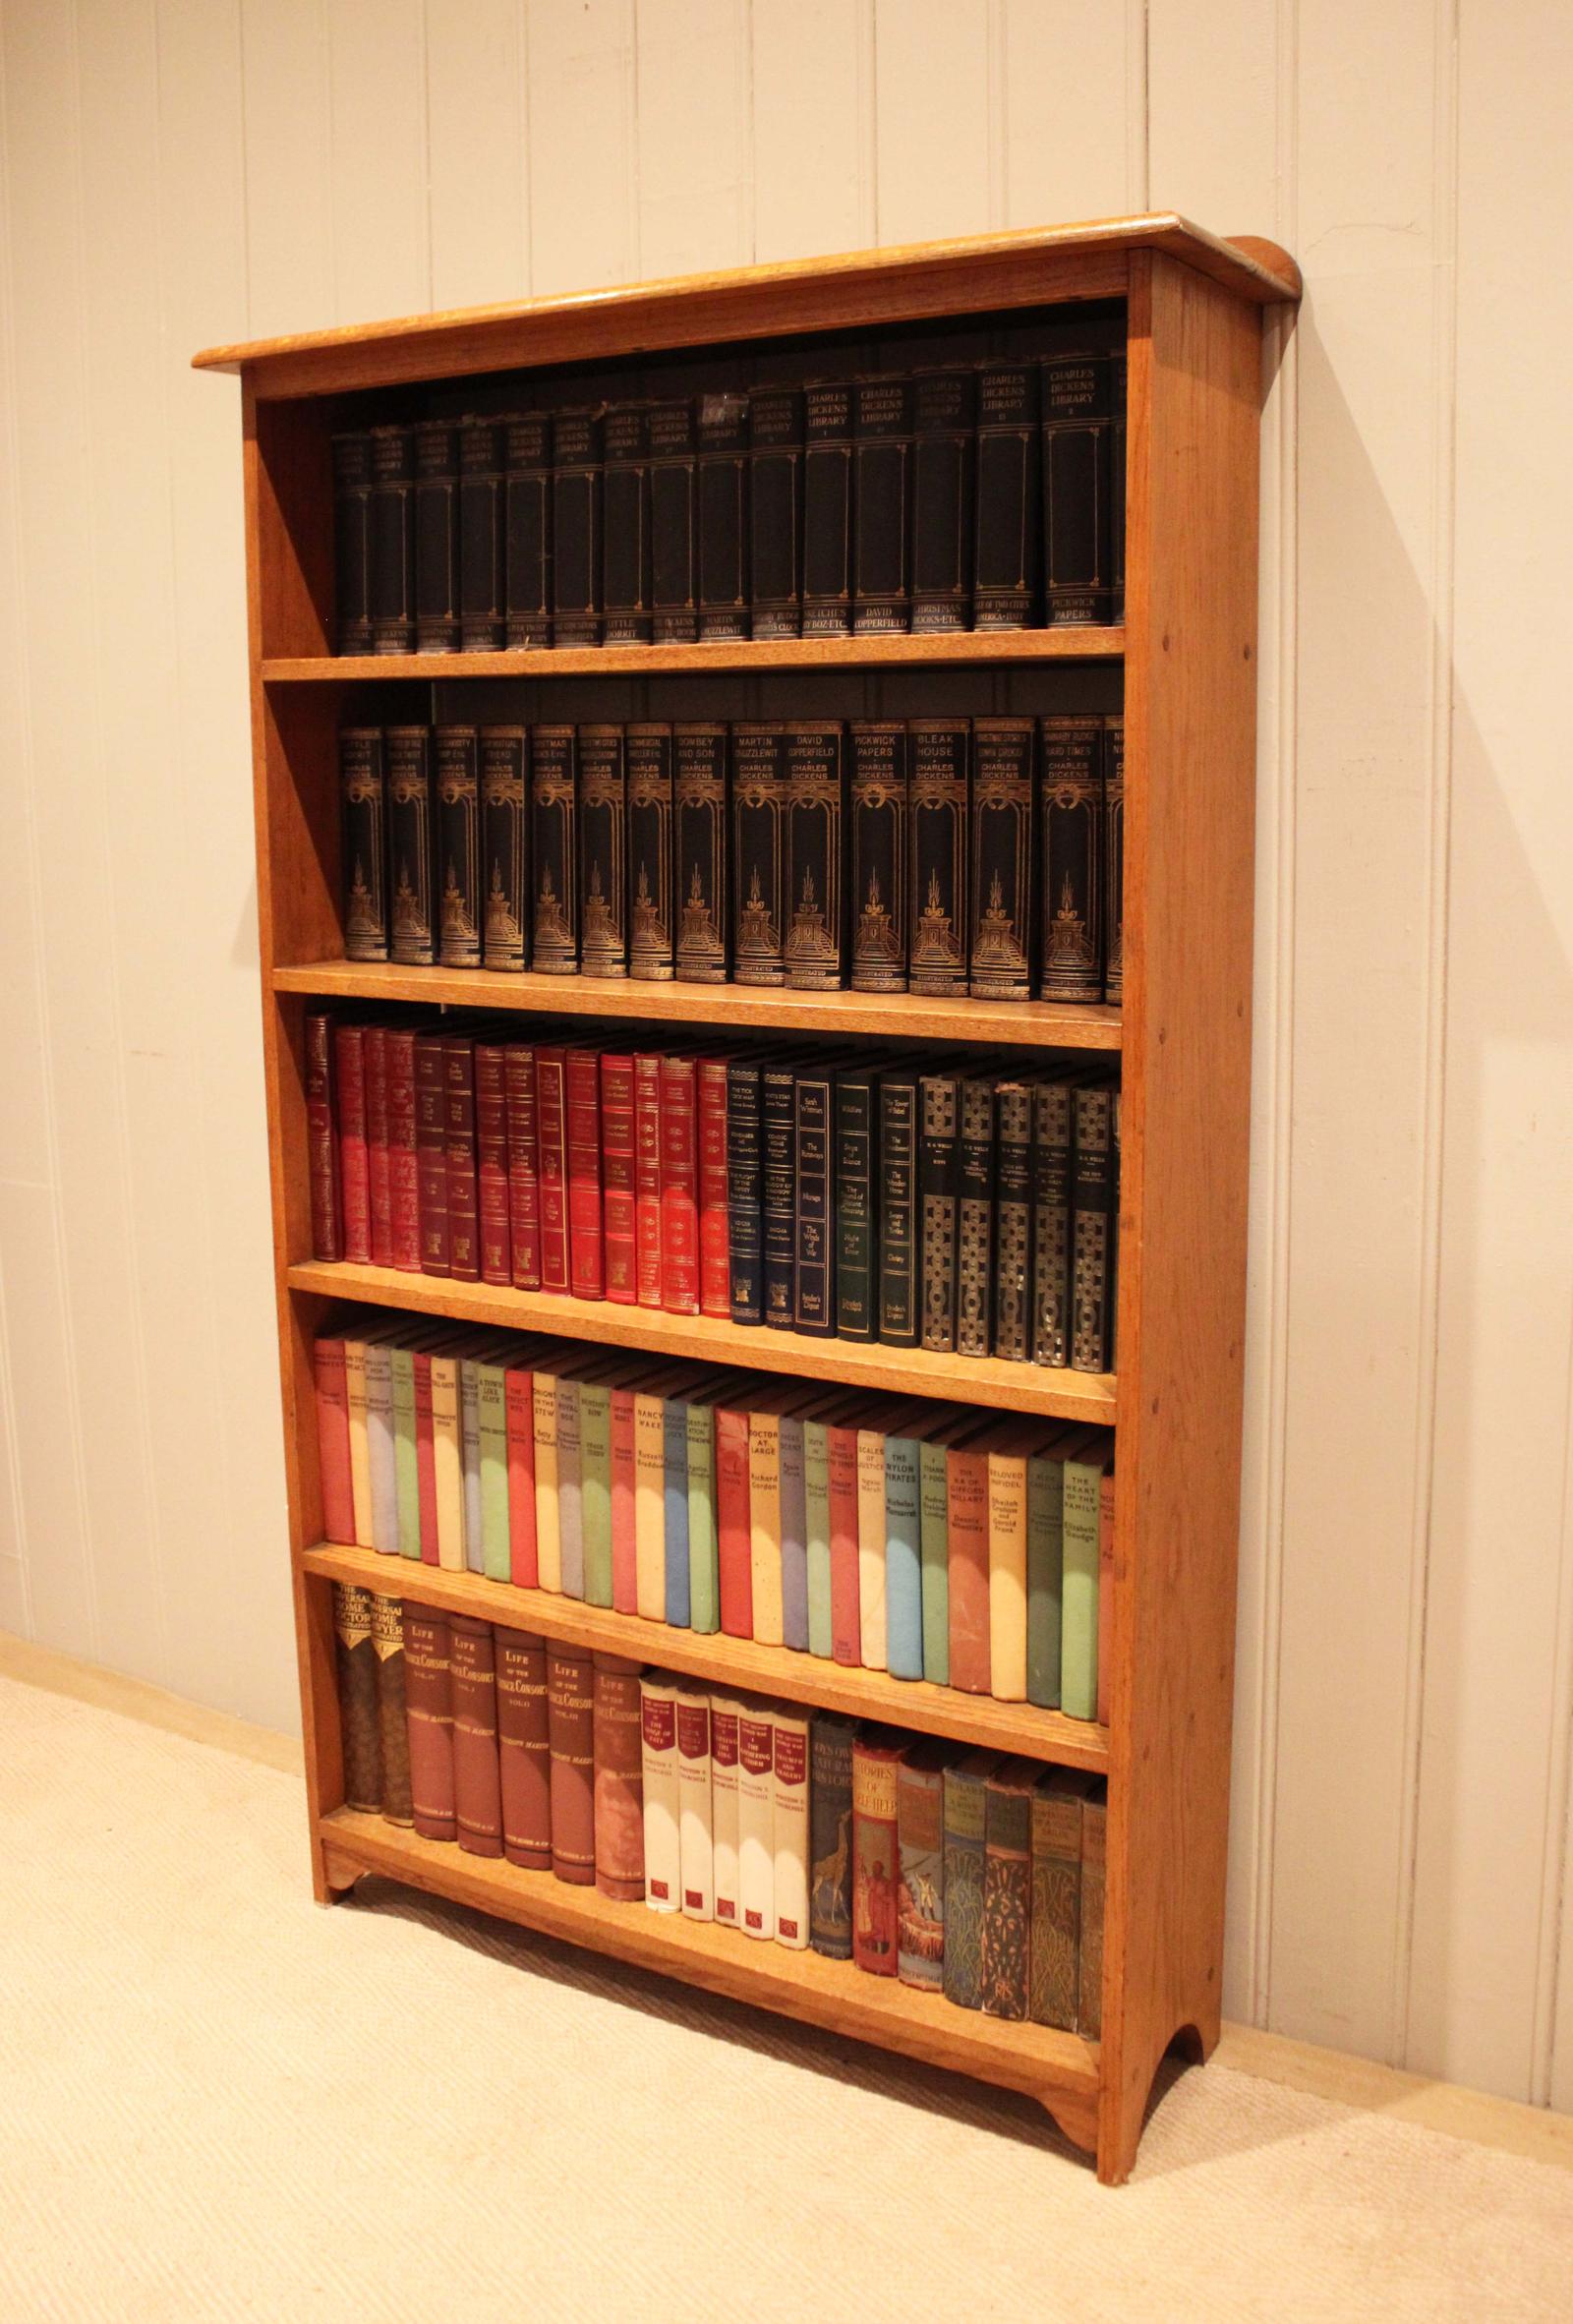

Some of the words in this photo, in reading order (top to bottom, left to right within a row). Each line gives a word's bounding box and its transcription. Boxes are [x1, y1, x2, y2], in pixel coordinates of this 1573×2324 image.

[1050, 369, 1094, 380] CHARLES
[983, 375, 1024, 385] CHARLES
[983, 386, 1024, 397] DICKENS
[1051, 380, 1094, 393] DICKENS
[807, 393, 848, 403] CHARLES
[860, 388, 903, 399] CHARLES
[860, 399, 903, 410] DICKENS
[983, 399, 1022, 410] LIBRARY
[1051, 393, 1095, 408] LIBRARY
[807, 404, 847, 415] DICKENS
[808, 415, 846, 426] LIBRARY
[861, 412, 902, 424] LIBRARY
[1052, 597, 1095, 608] PICKWICK
[866, 607, 892, 615] DAVID
[1054, 609, 1091, 620] PAPERS
[678, 737, 714, 746] DOMBEY
[739, 737, 772, 746] MARTIN
[796, 735, 823, 745] DAVID
[854, 735, 896, 745] PICKWICK
[917, 734, 954, 744] BLEAK
[696, 749, 715, 758] SON
[856, 748, 894, 757] PAPERS
[917, 747, 953, 756] HOUSE
[1048, 771, 1089, 780] DICKENS
[534, 1408, 554, 1417] STEW
[637, 1409, 664, 1421] NANCY
[639, 1421, 662, 1430] WAKE
[749, 1429, 778, 1438] DOCTOR
[751, 1447, 776, 1456] LARGE
[892, 1454, 906, 1463] THE
[886, 1464, 914, 1474] NYLON
[751, 1472, 778, 1482] Richard
[886, 1473, 915, 1483] PIRATES
[989, 1469, 1023, 1480] BELOVED
[752, 1481, 778, 1490] Gordon
[1065, 1484, 1096, 1495] HEART
[1078, 1495, 1094, 1505] THE
[1064, 1502, 1098, 1513] FAMILY
[1064, 1521, 1097, 1535] Elizabeth
[564, 1682, 578, 1691] THE
[747, 1742, 759, 1751] THE
[776, 1753, 803, 1765] TRIUMPH
[782, 1763, 795, 1772] AND
[776, 1768, 802, 1780] TRAGEDY
[866, 1780, 879, 1793] OF
